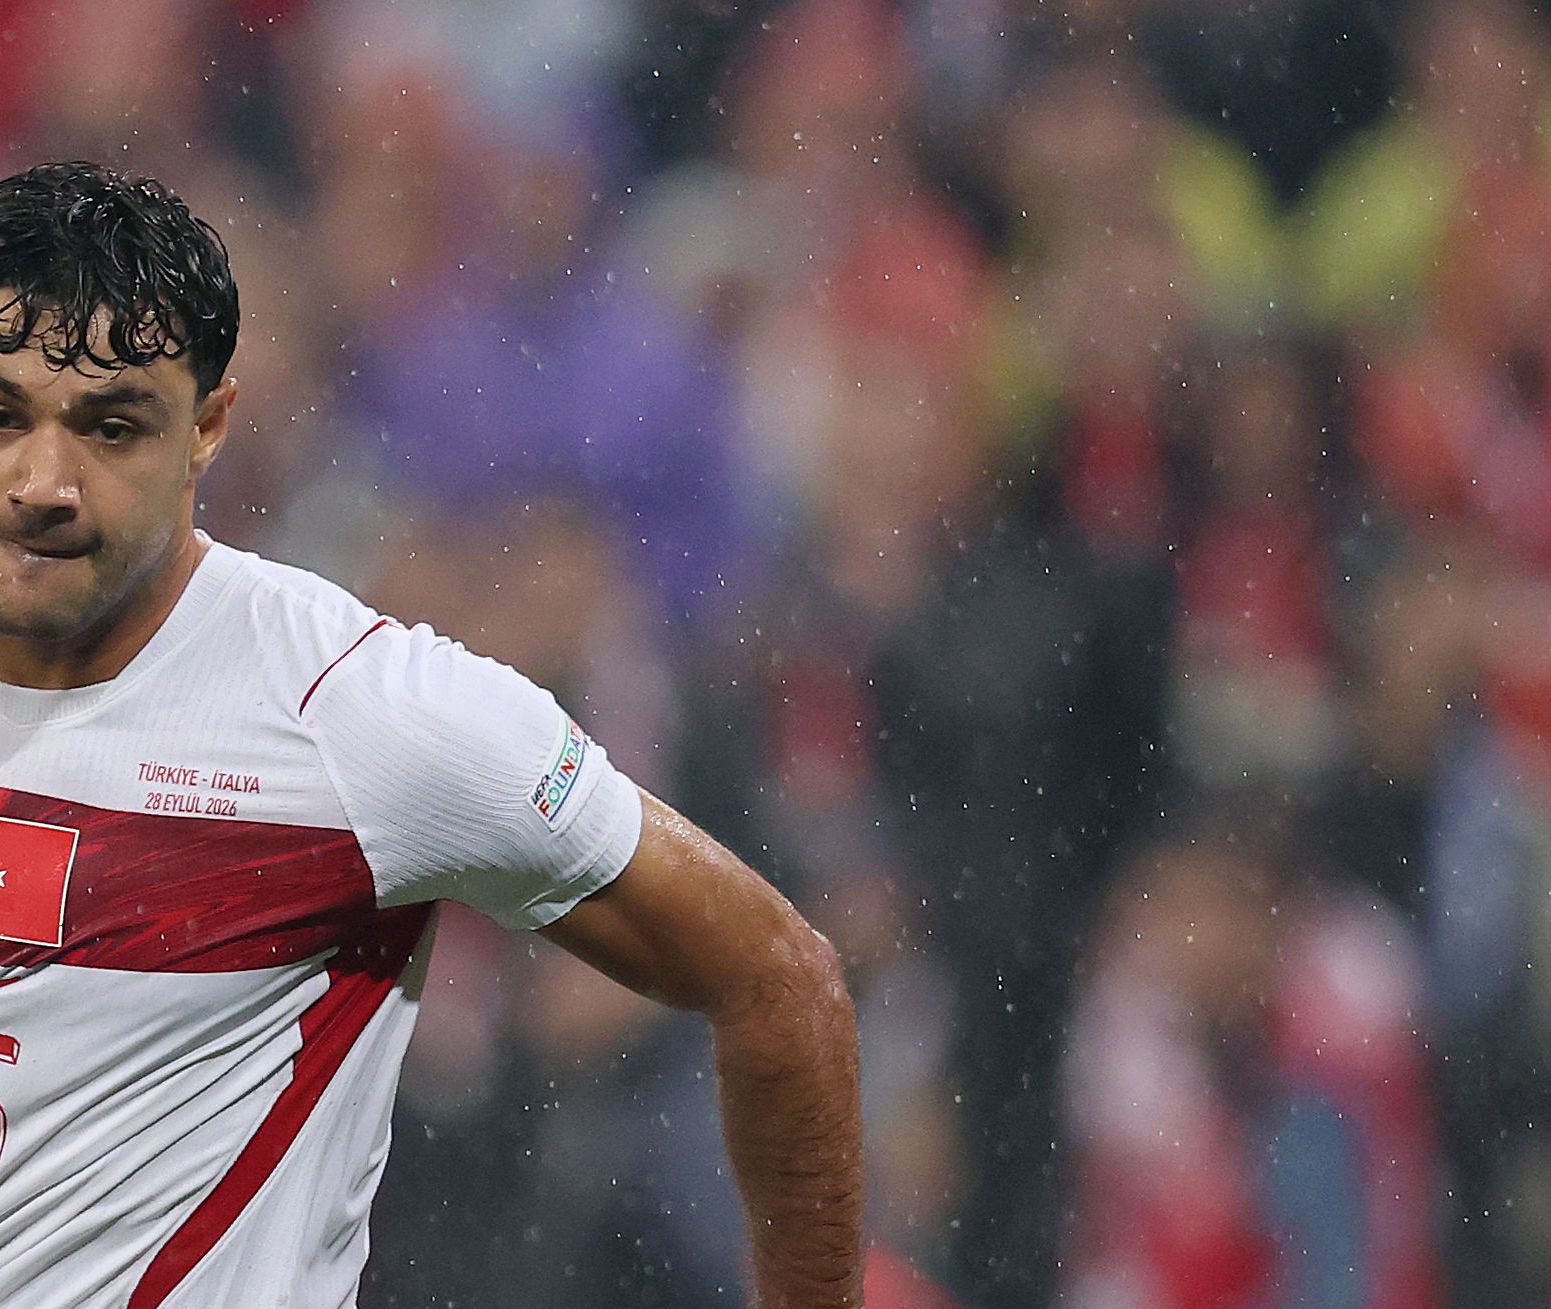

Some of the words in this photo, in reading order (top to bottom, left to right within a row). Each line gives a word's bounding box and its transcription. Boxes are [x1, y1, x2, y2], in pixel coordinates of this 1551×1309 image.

[138, 761, 199, 786] TÜRKİYE
[211, 769, 260, 794] İTALYA
[144, 792, 162, 809] 28
[163, 793, 202, 813] EYLÜL
[205, 798, 237, 816] 2026
